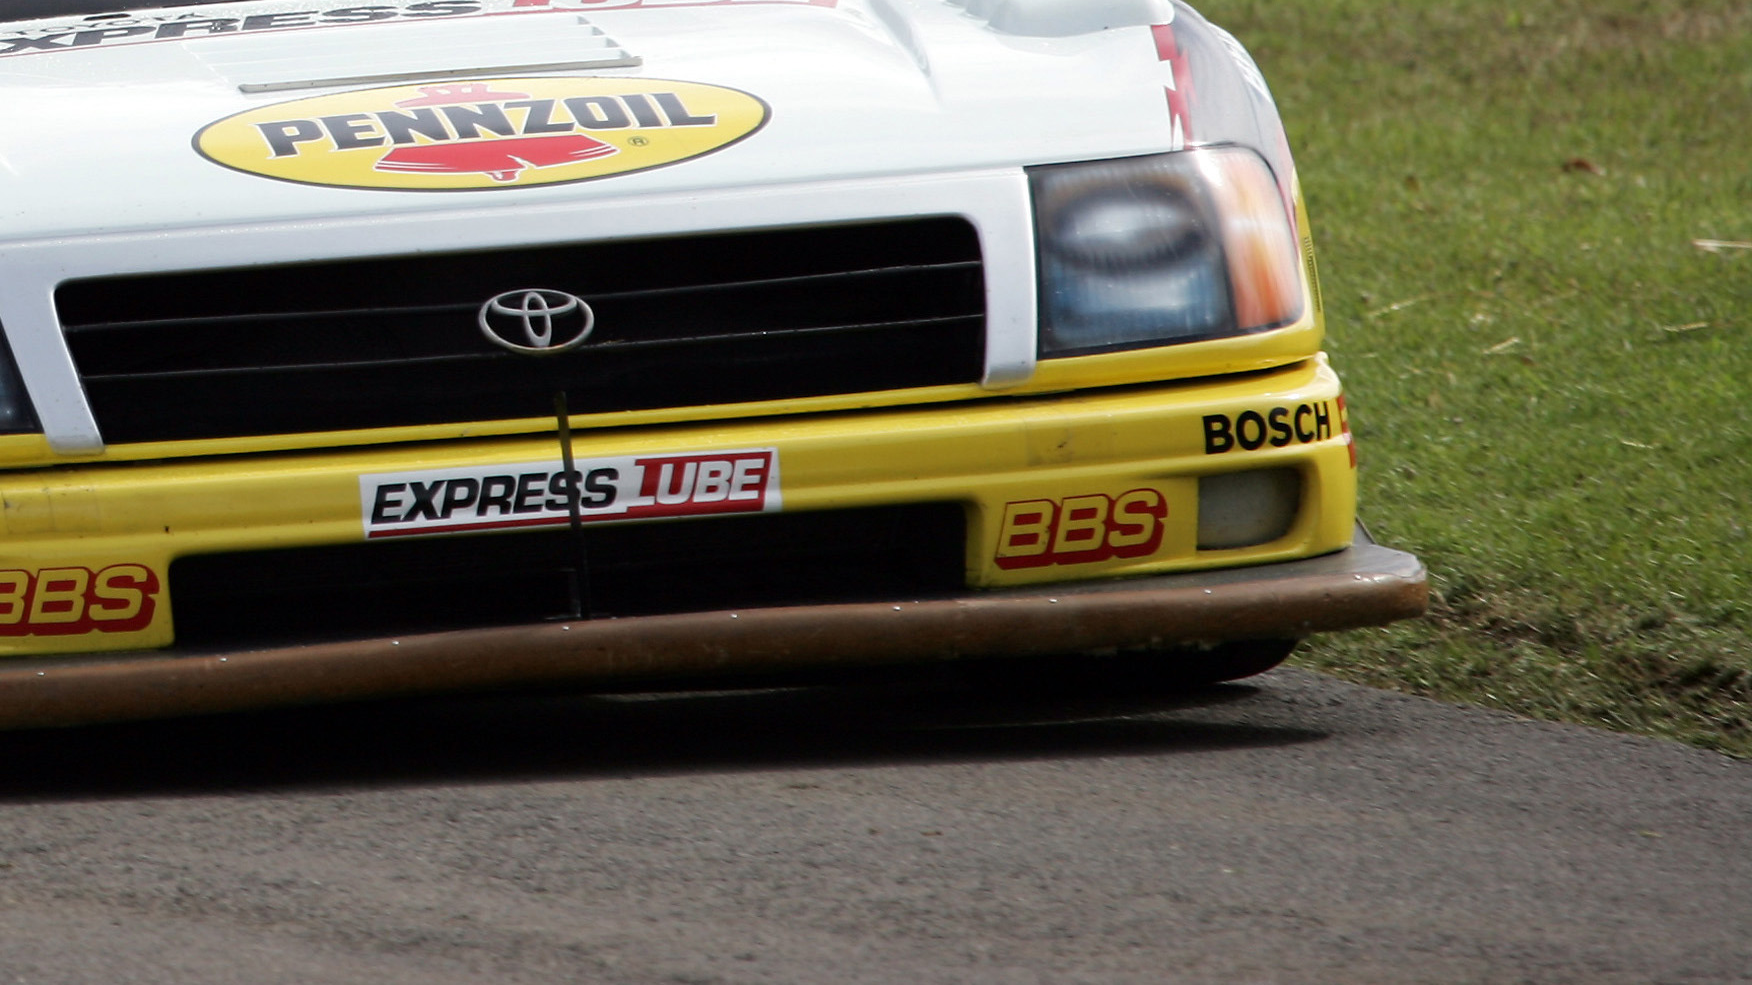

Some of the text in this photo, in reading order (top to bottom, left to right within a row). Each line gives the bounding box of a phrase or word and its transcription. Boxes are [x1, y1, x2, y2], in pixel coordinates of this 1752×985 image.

[254, 85, 719, 161] PENNZOIL
[1202, 400, 1332, 455] BOSCH
[369, 454, 767, 526] EXPRESS LUBE
[994, 487, 1168, 571] BBS
